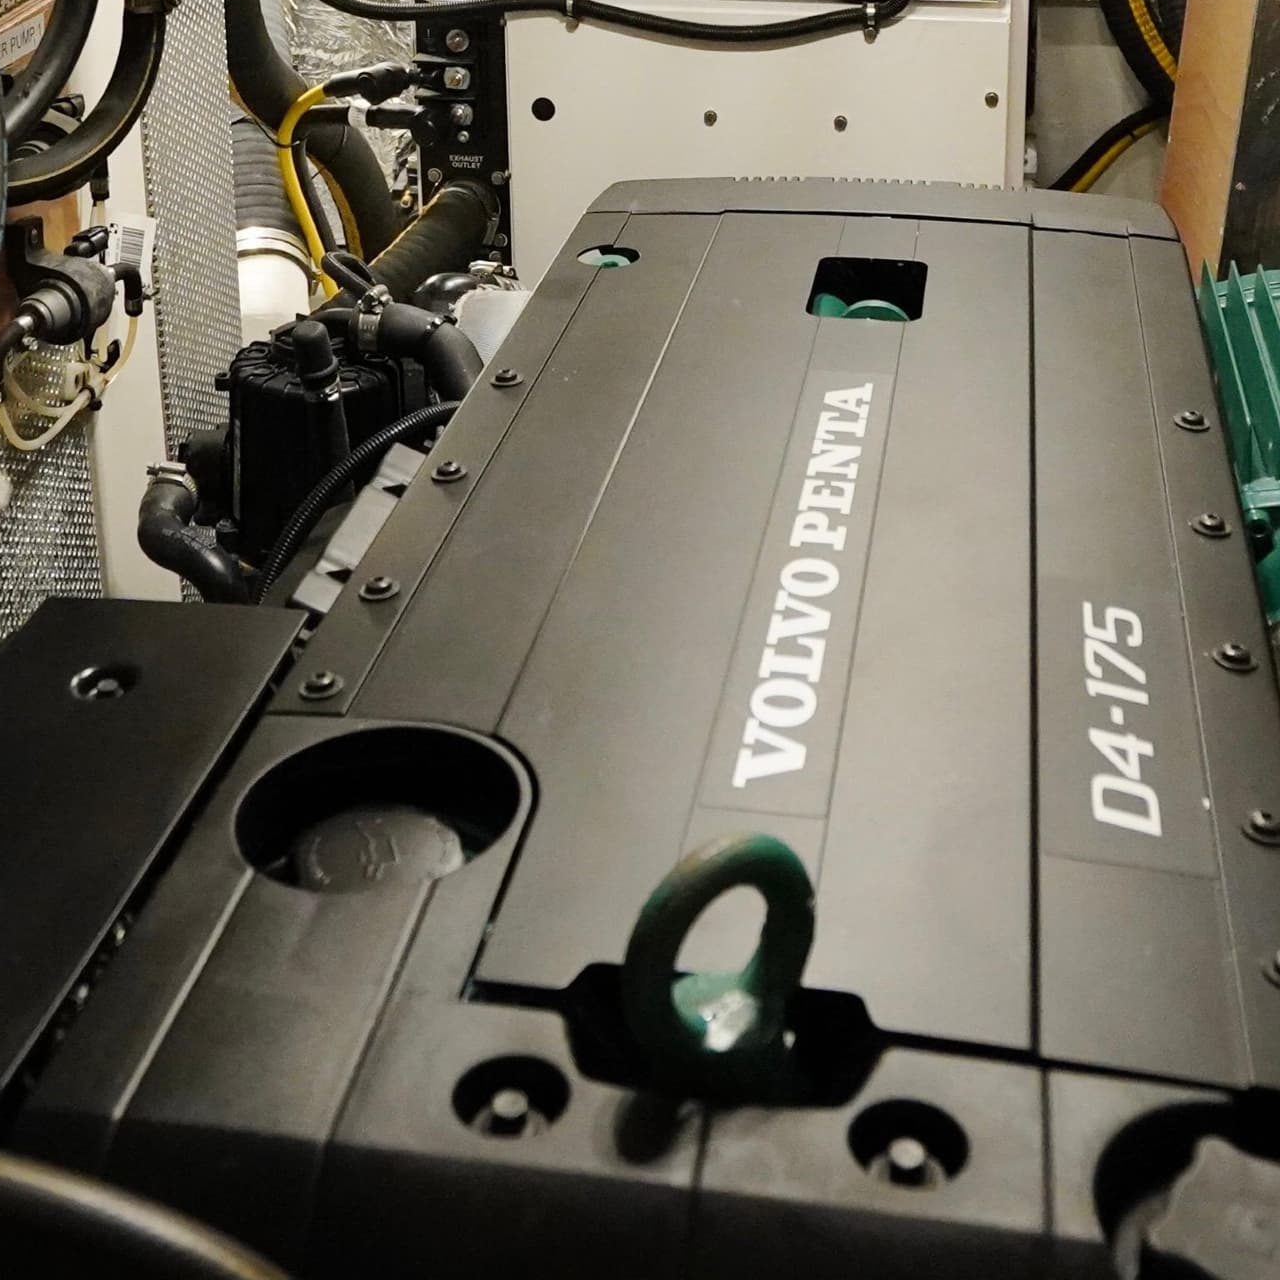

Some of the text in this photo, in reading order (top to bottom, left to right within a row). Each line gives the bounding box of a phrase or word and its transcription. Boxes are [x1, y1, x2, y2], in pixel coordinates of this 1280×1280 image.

[10, 26, 37, 53] PUMP
[449, 154, 484, 163] EXHAUST
[451, 161, 481, 169] OUTLET
[731, 381, 875, 789] VOLVO PENTA
[1081, 600, 1163, 838] D4-175
